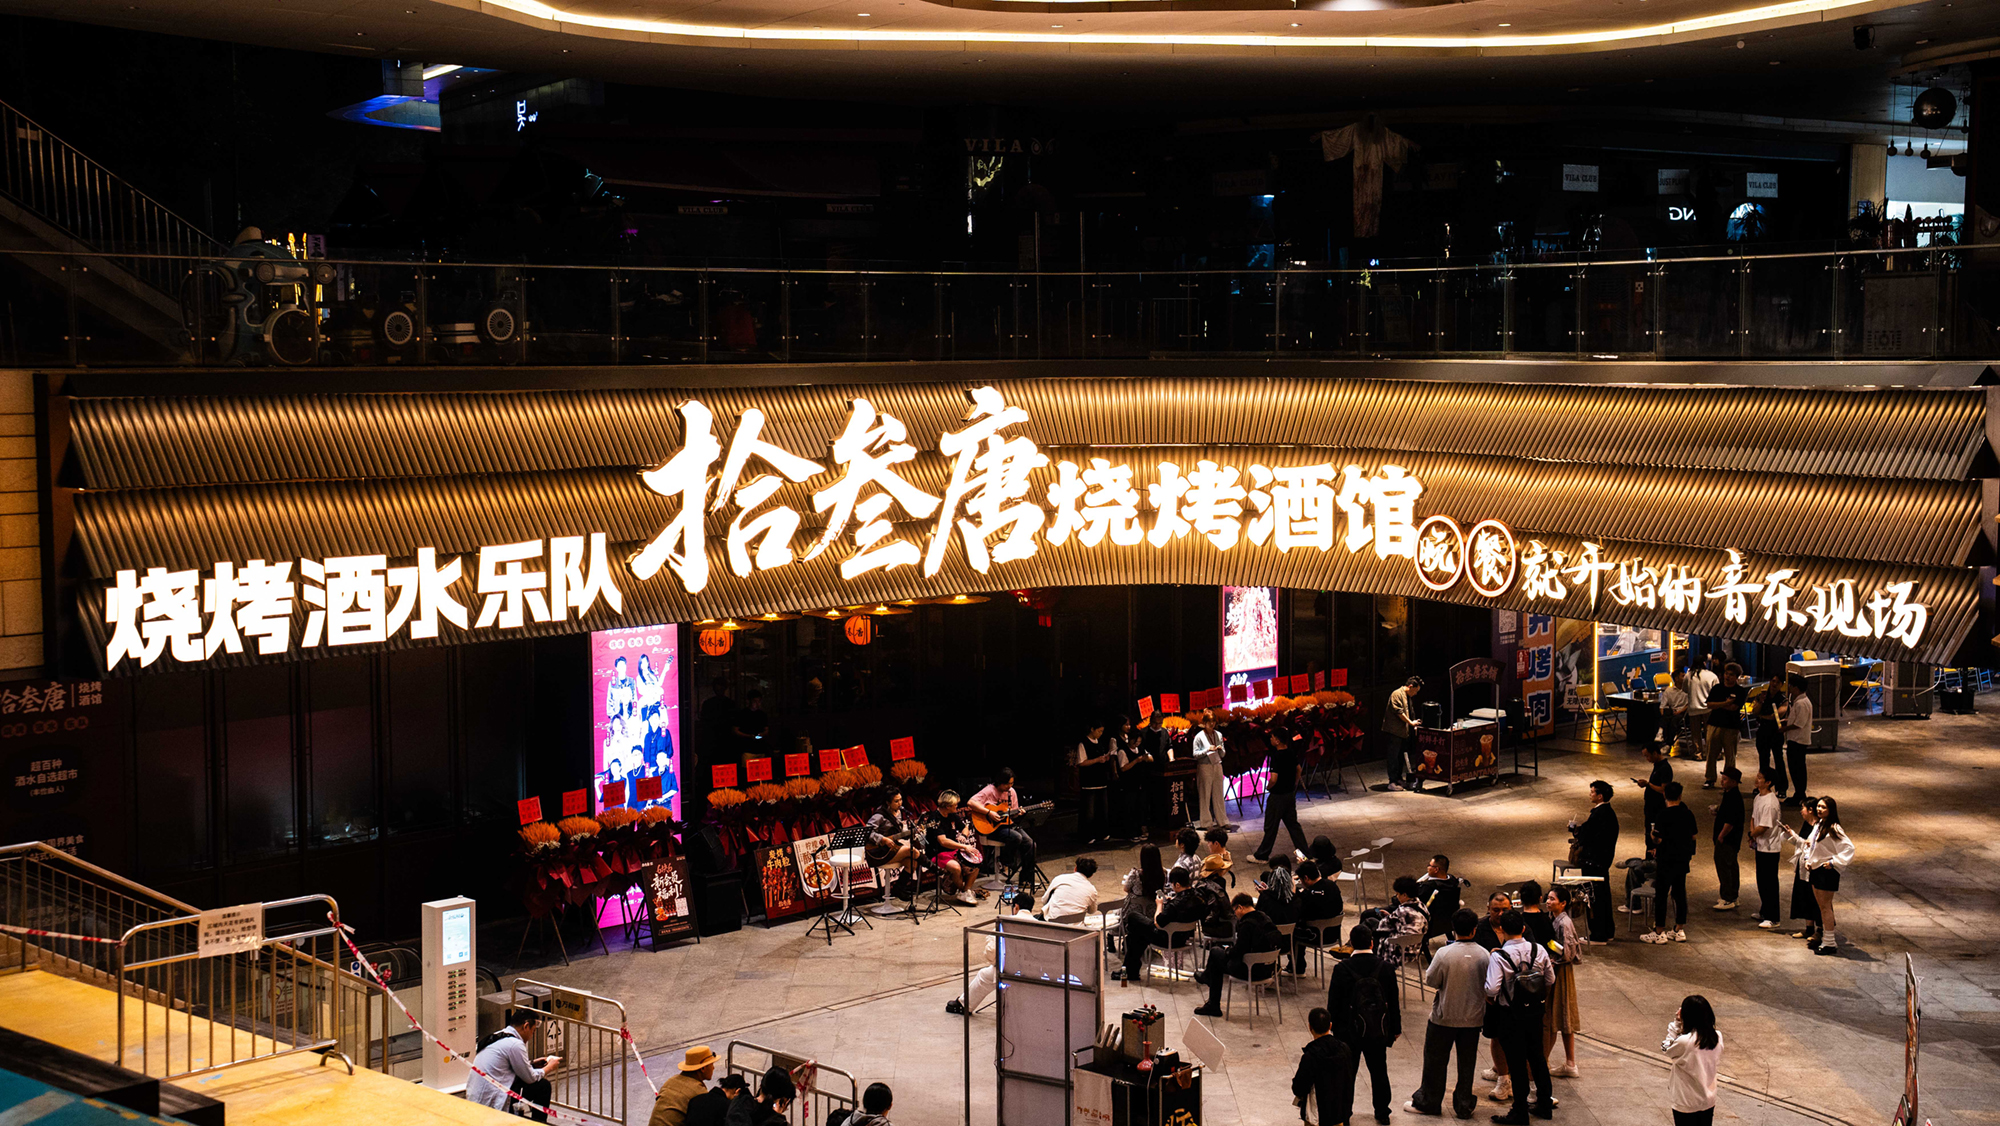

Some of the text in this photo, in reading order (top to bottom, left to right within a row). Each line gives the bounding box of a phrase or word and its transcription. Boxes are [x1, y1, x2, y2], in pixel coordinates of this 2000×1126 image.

[963, 138, 1024, 153] VILA
[625, 387, 1424, 594] 拾叁唐 烧烤酒馆
[105, 532, 623, 671] 烧烤酒水乐队
[30, 758, 63, 772] 超百种
[14, 769, 79, 787] 酒水自选超市
[650, 870, 684, 891] 新会员
